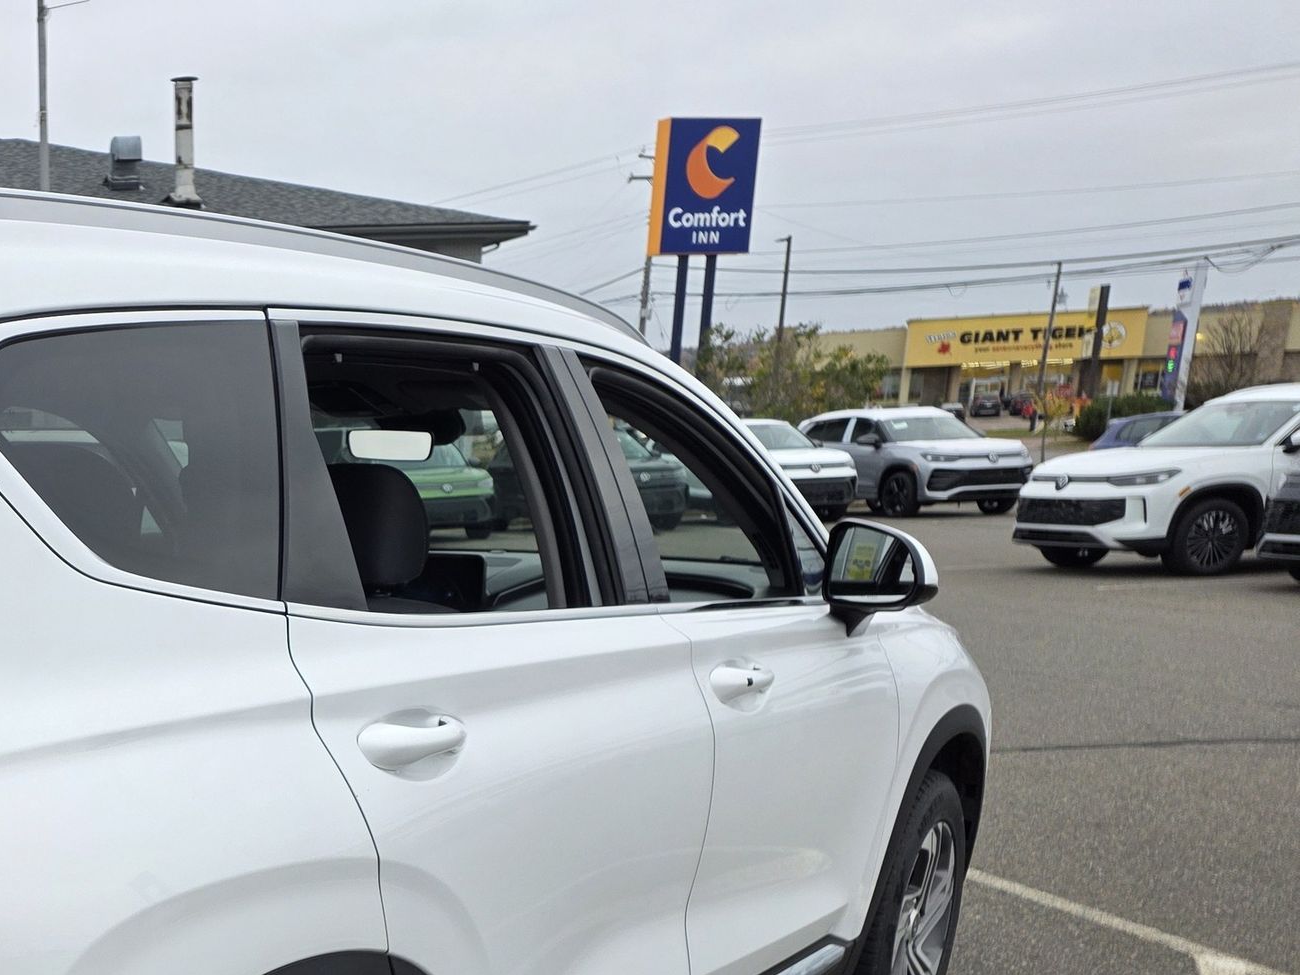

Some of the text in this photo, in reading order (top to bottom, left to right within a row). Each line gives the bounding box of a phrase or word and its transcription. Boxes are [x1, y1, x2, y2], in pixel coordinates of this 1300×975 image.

[668, 205, 747, 228] Comfort
[691, 230, 720, 244] INN
[960, 327, 1024, 345] GIANT
